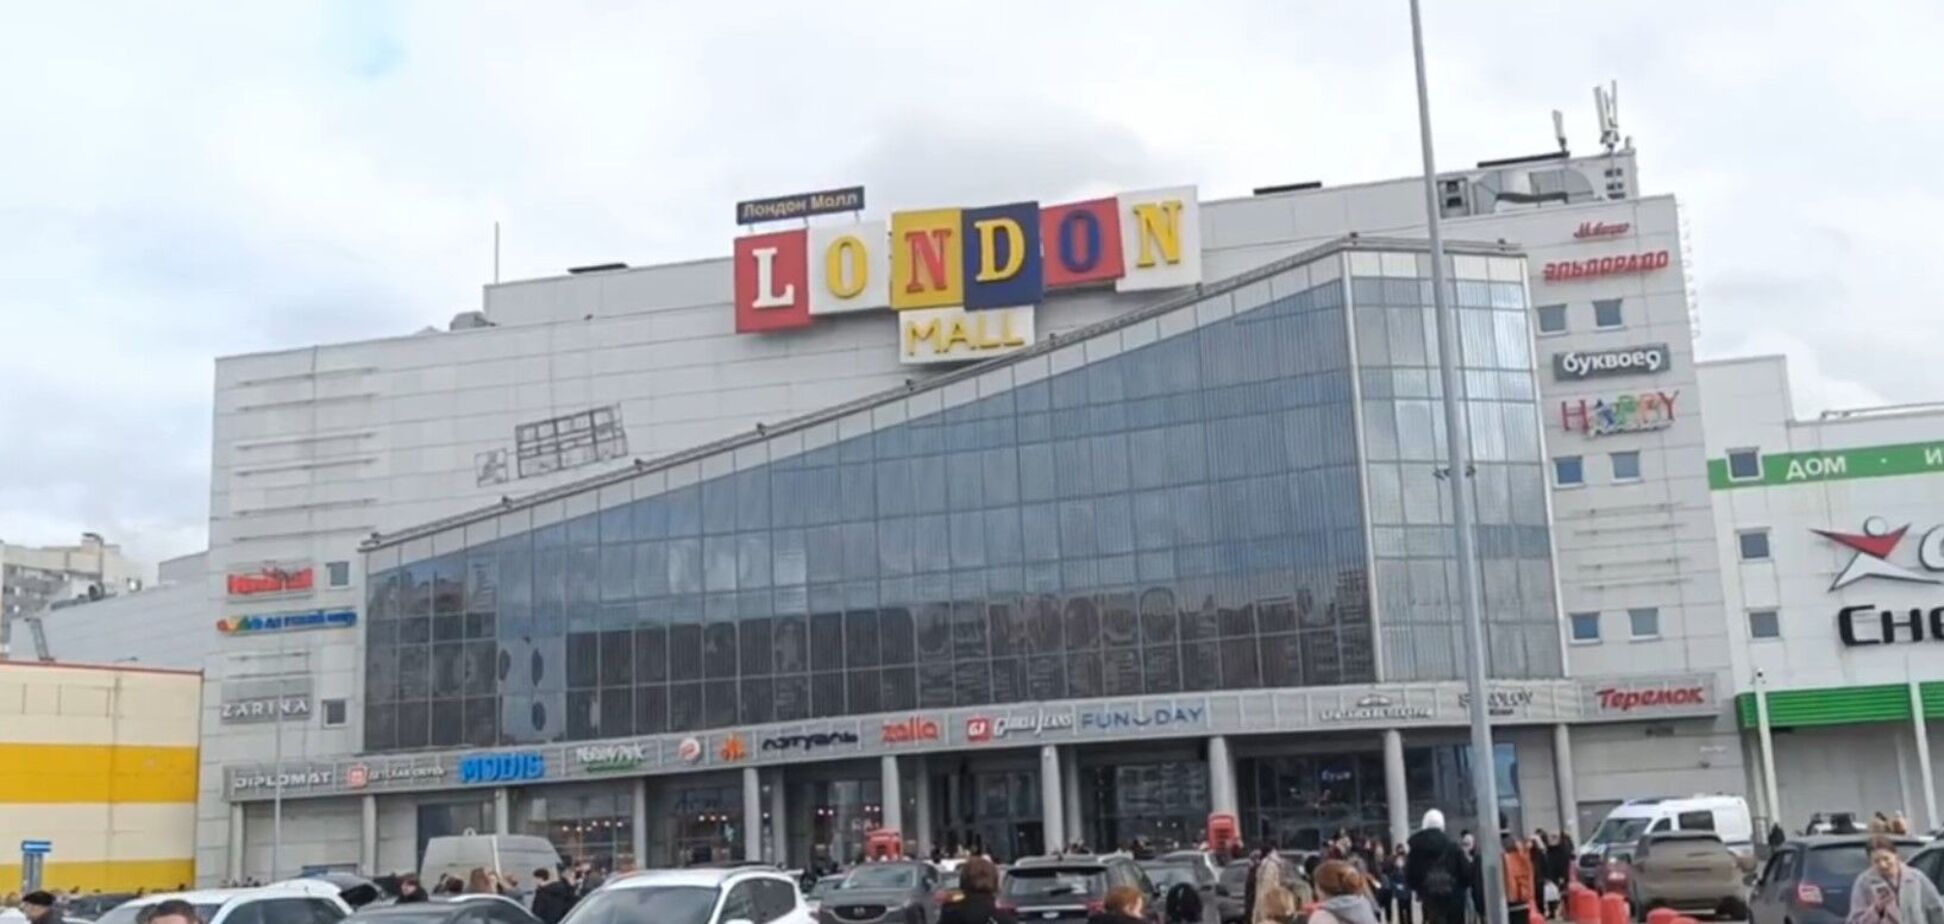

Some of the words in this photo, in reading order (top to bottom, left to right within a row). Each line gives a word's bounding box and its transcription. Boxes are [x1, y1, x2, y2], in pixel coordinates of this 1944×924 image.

[743, 200, 806, 219] Лондон
[811, 193, 858, 210] Молл
[752, 201, 1184, 309] LONDON
[1544, 250, 1669, 281] ЭЛЬДОРАДО
[908, 311, 1025, 356] MALL
[1563, 350, 1661, 375] буквоед
[1785, 456, 1846, 480] ДОМ
[222, 700, 309, 718] ZARINA
[1596, 687, 1706, 711] Теремок
[1081, 709, 1129, 729] FUN
[1155, 707, 1203, 726] DAY
[234, 771, 331, 789] DIPLOMAT
[461, 752, 545, 784] MODIS
